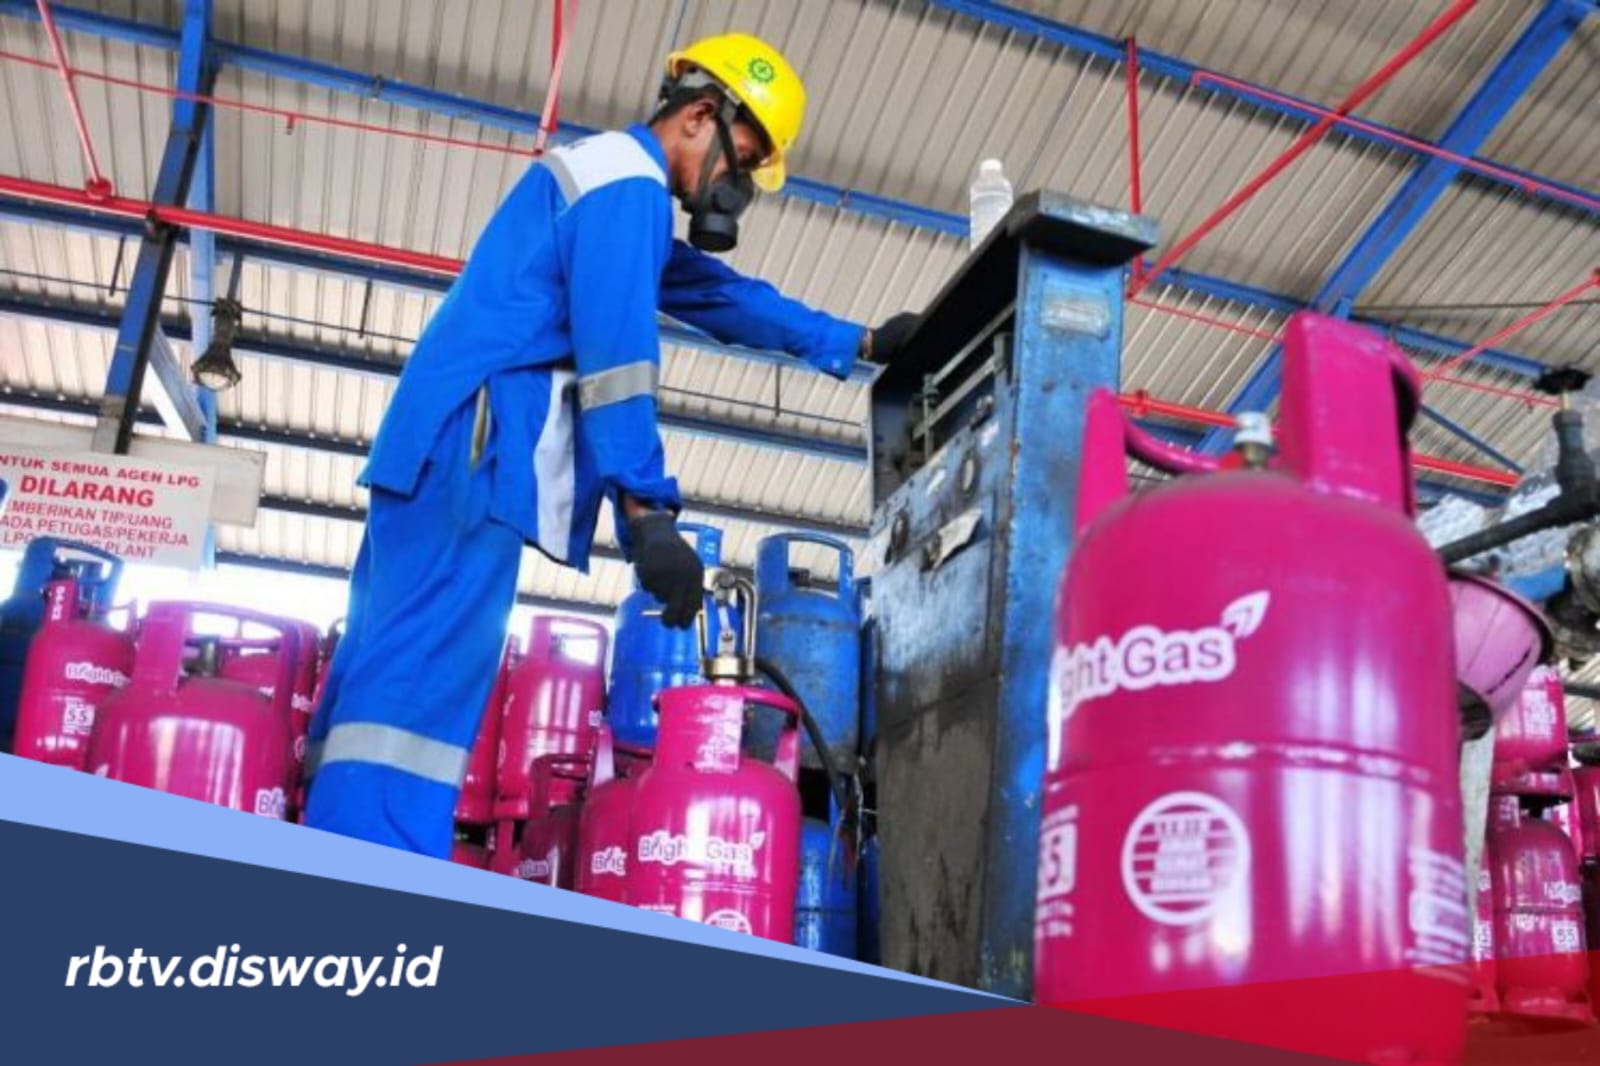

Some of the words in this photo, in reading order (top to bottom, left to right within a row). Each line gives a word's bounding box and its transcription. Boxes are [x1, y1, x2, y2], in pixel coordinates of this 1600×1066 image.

[51, 461, 109, 477] SEMUA
[117, 468, 163, 484] AGEN
[167, 474, 200, 488] LPG
[20, 475, 155, 508] DILARANG
[38, 518, 189, 546] PETUGAS/PEKERJA
[105, 540, 156, 558] PLANT
[1122, 635, 1224, 681] Gas
